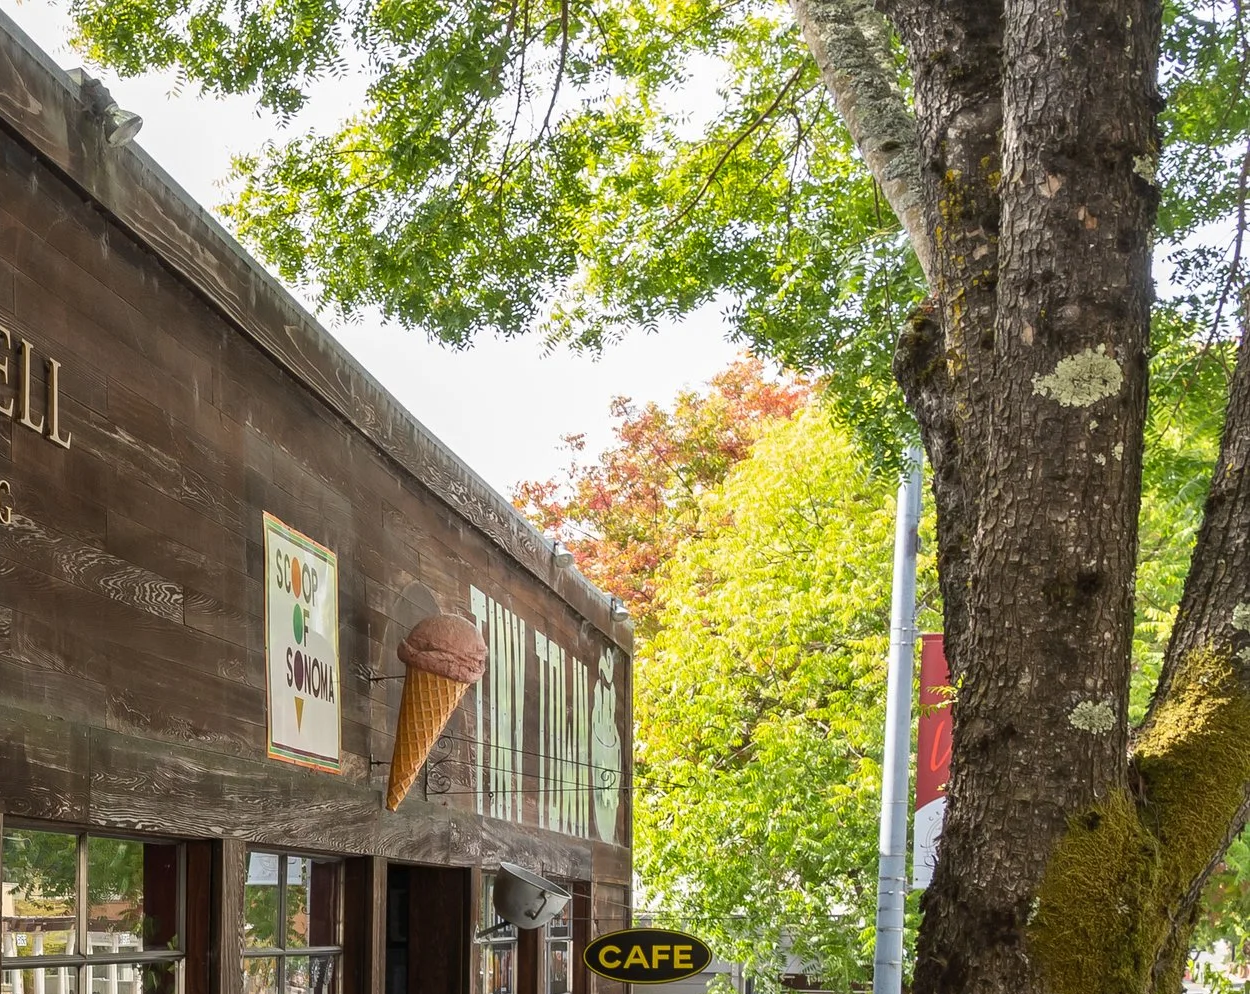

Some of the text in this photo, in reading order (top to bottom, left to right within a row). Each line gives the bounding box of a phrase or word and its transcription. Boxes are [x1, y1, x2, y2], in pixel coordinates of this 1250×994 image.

[276, 549, 318, 607] SCOOP
[293, 603, 309, 647] OF
[286, 647, 334, 703] SONOMA
[470, 584, 590, 840] TINY TOWN
[598, 945, 694, 969] CAFE
